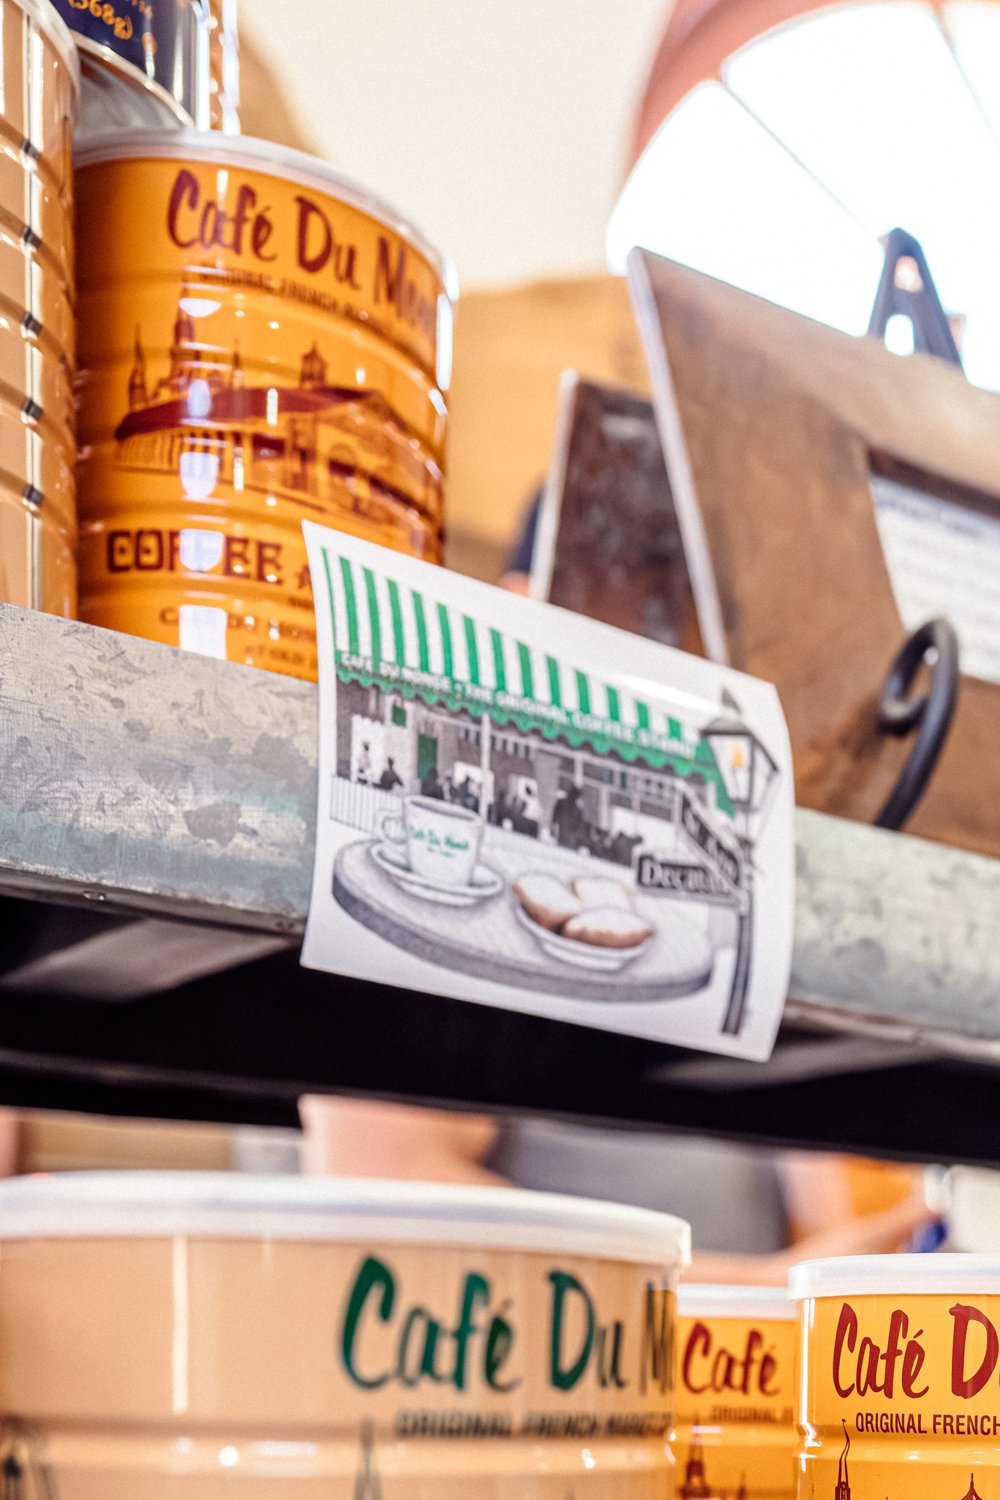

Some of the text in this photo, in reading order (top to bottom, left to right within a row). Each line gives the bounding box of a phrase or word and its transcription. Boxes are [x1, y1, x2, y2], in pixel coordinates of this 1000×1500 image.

[167, 168, 277, 262] Café
[295, 196, 361, 290] Du
[107, 528, 282, 586] COEE
[341, 1255, 628, 1393] Café Du
[682, 1321, 781, 1397] Café
[833, 1303, 929, 1399] Café
[856, 1412, 927, 1435] ORIGINAL
